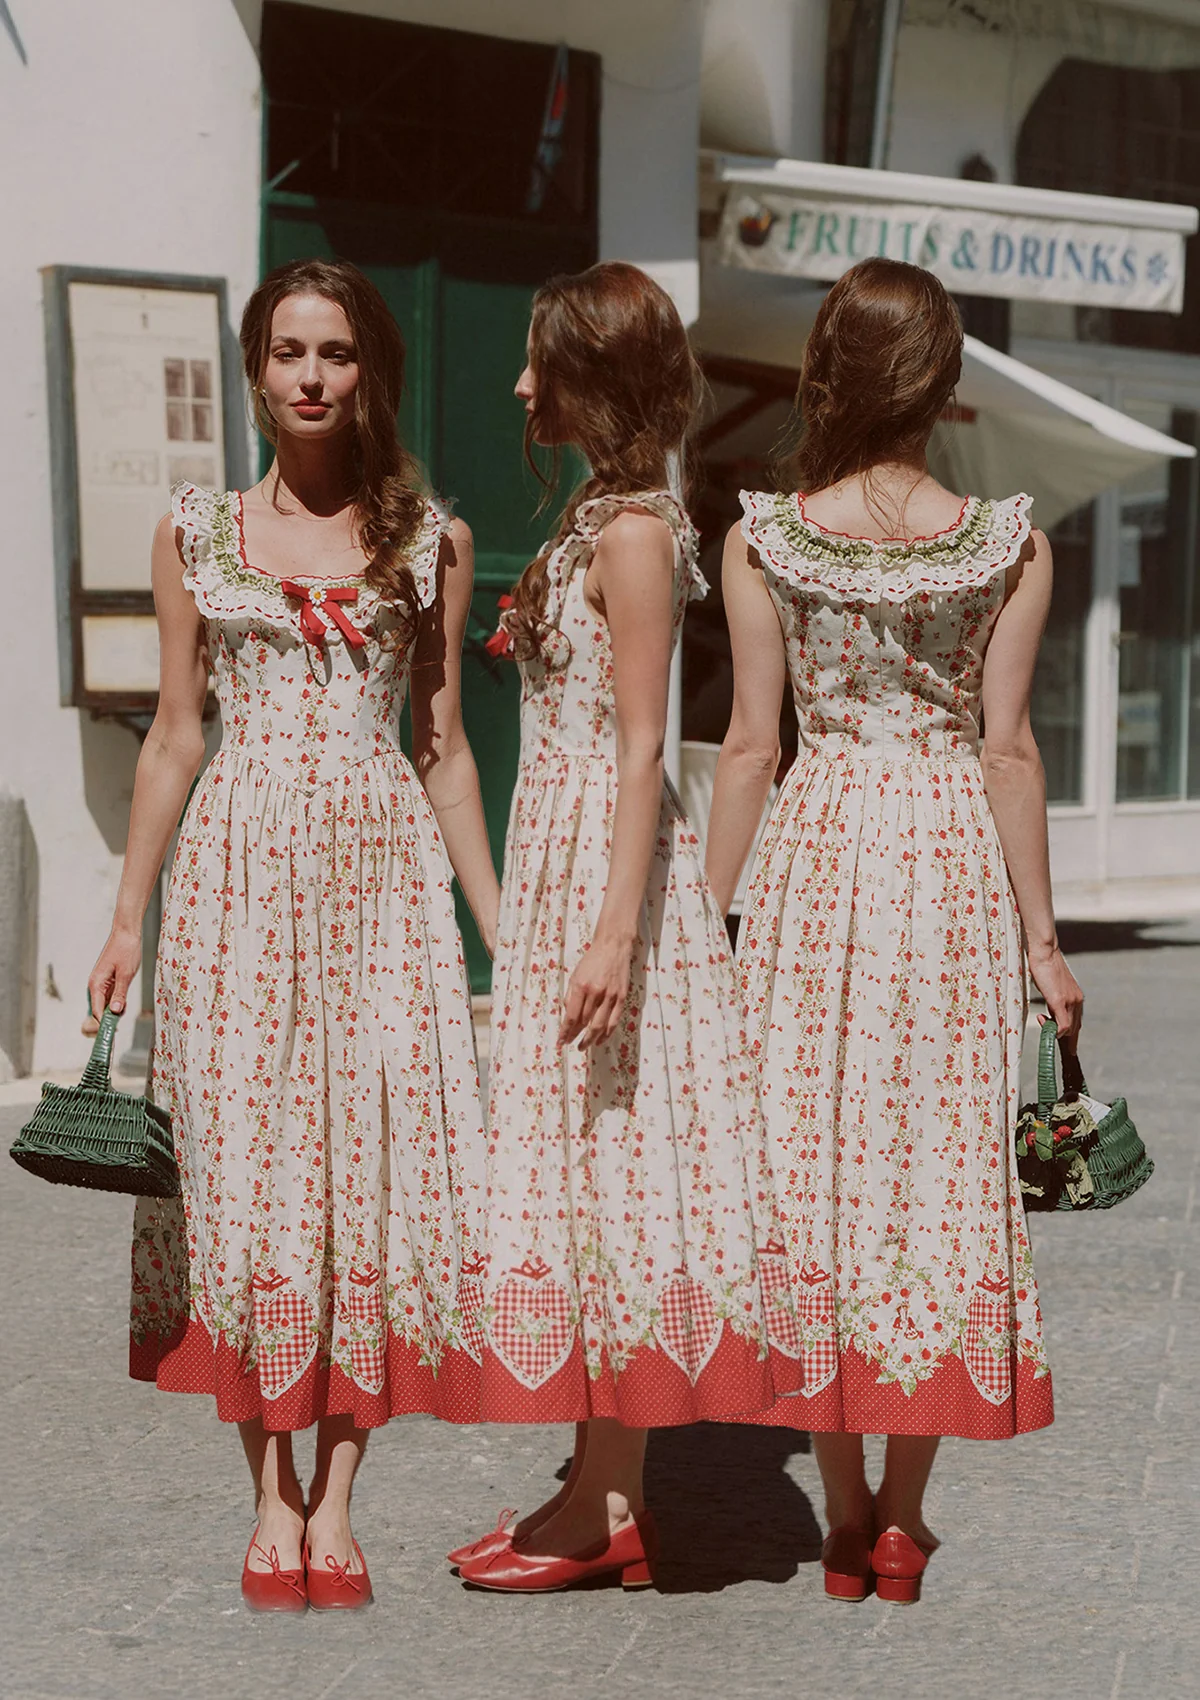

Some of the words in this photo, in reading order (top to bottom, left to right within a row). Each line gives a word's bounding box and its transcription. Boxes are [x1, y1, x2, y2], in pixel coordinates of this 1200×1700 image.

[786, 210, 941, 266] FRUITS
[951, 230, 977, 271] &
[990, 232, 1138, 286] DRINKS
